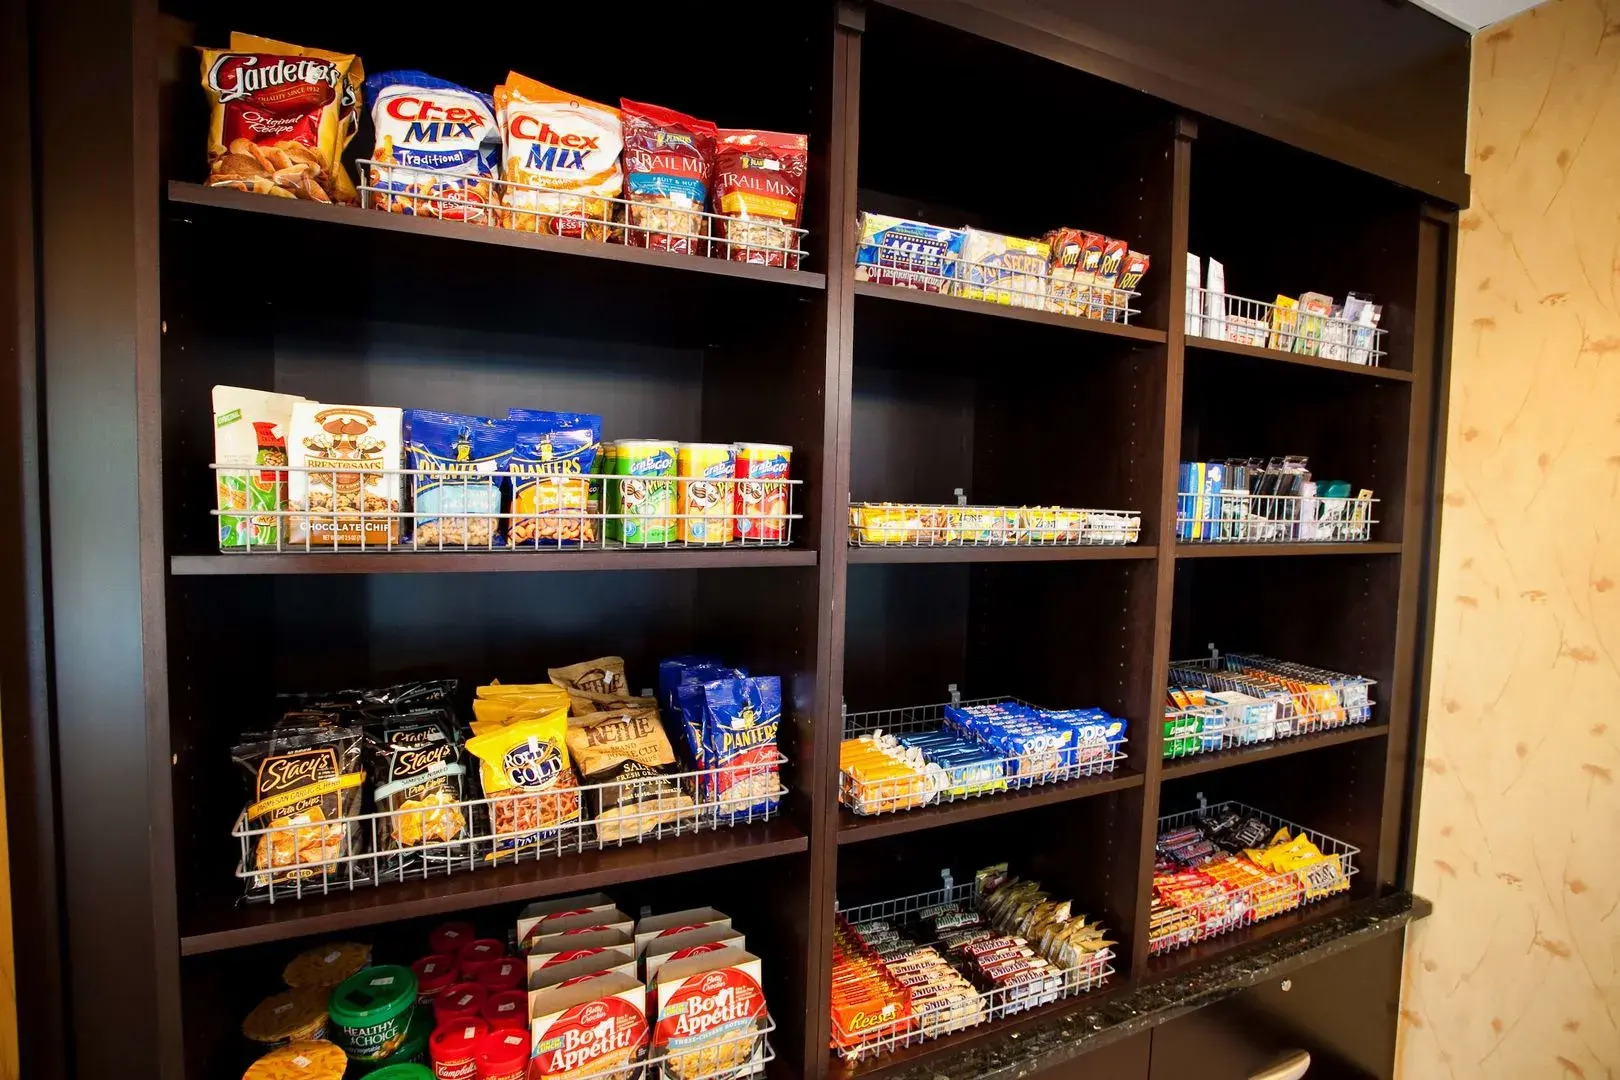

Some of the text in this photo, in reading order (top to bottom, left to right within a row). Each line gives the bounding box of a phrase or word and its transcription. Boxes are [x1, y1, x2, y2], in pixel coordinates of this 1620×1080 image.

[208, 55, 340, 102] Gardetto's
[258, 93, 287, 103] QUALITY
[287, 87, 305, 97] SINCE
[242, 112, 304, 127] Original
[387, 97, 485, 126] Chex
[246, 120, 294, 134] Recipe
[403, 122, 477, 143] MIX
[510, 115, 600, 149] Chex
[399, 150, 463, 167] Traditional
[525, 143, 592, 171] MIX
[633, 150, 680, 172] TRAIL
[652, 176, 674, 184] FRUIT
[681, 179, 698, 187] NUT
[719, 173, 797, 197] TRAIL MIX
[1003, 254, 1044, 274] SECRET
[1061, 247, 1081, 267] RITZ
[1100, 255, 1122, 275] RITZ
[1119, 272, 1143, 289] RITZ
[419, 459, 480, 481] PLANTE
[509, 457, 582, 479] PLANTERS
[655, 458, 673, 470] GO!
[772, 462, 788, 473] GO!
[299, 523, 362, 532] CHOCOLATE
[723, 722, 779, 752] PLANTERS
[394, 744, 451, 775] Stacy's
[638, 745, 658, 756] CUT
[260, 754, 330, 793] Stacy's
[510, 756, 563, 786] GOLD
[616, 772, 640, 782] FRESH
[425, 776, 447, 788] Chips
[257, 795, 289, 810] PARMESAN
[290, 787, 315, 800] GARLIC
[275, 796, 320, 818] Pita Chips
[974, 940, 1010, 953] SNICKERS
[980, 951, 1016, 964] SNICKERS
[896, 961, 936, 973] SNICKERS
[992, 961, 1029, 977] SNICKERS
[702, 982, 726, 992] Crocker
[706, 974, 723, 983] Betty
[903, 971, 944, 985] SNICKS
[1007, 970, 1044, 987] SNICKERS
[585, 1005, 604, 1015] Betty
[687, 987, 735, 1018] Bol
[580, 1011, 606, 1025] Crocker
[848, 1011, 896, 1032] Reeses
[343, 1018, 395, 1037] HEALTHY
[355, 1025, 399, 1047] CHOICE
[563, 1017, 616, 1053] Bol
[438, 1062, 477, 1079] Campbell's
